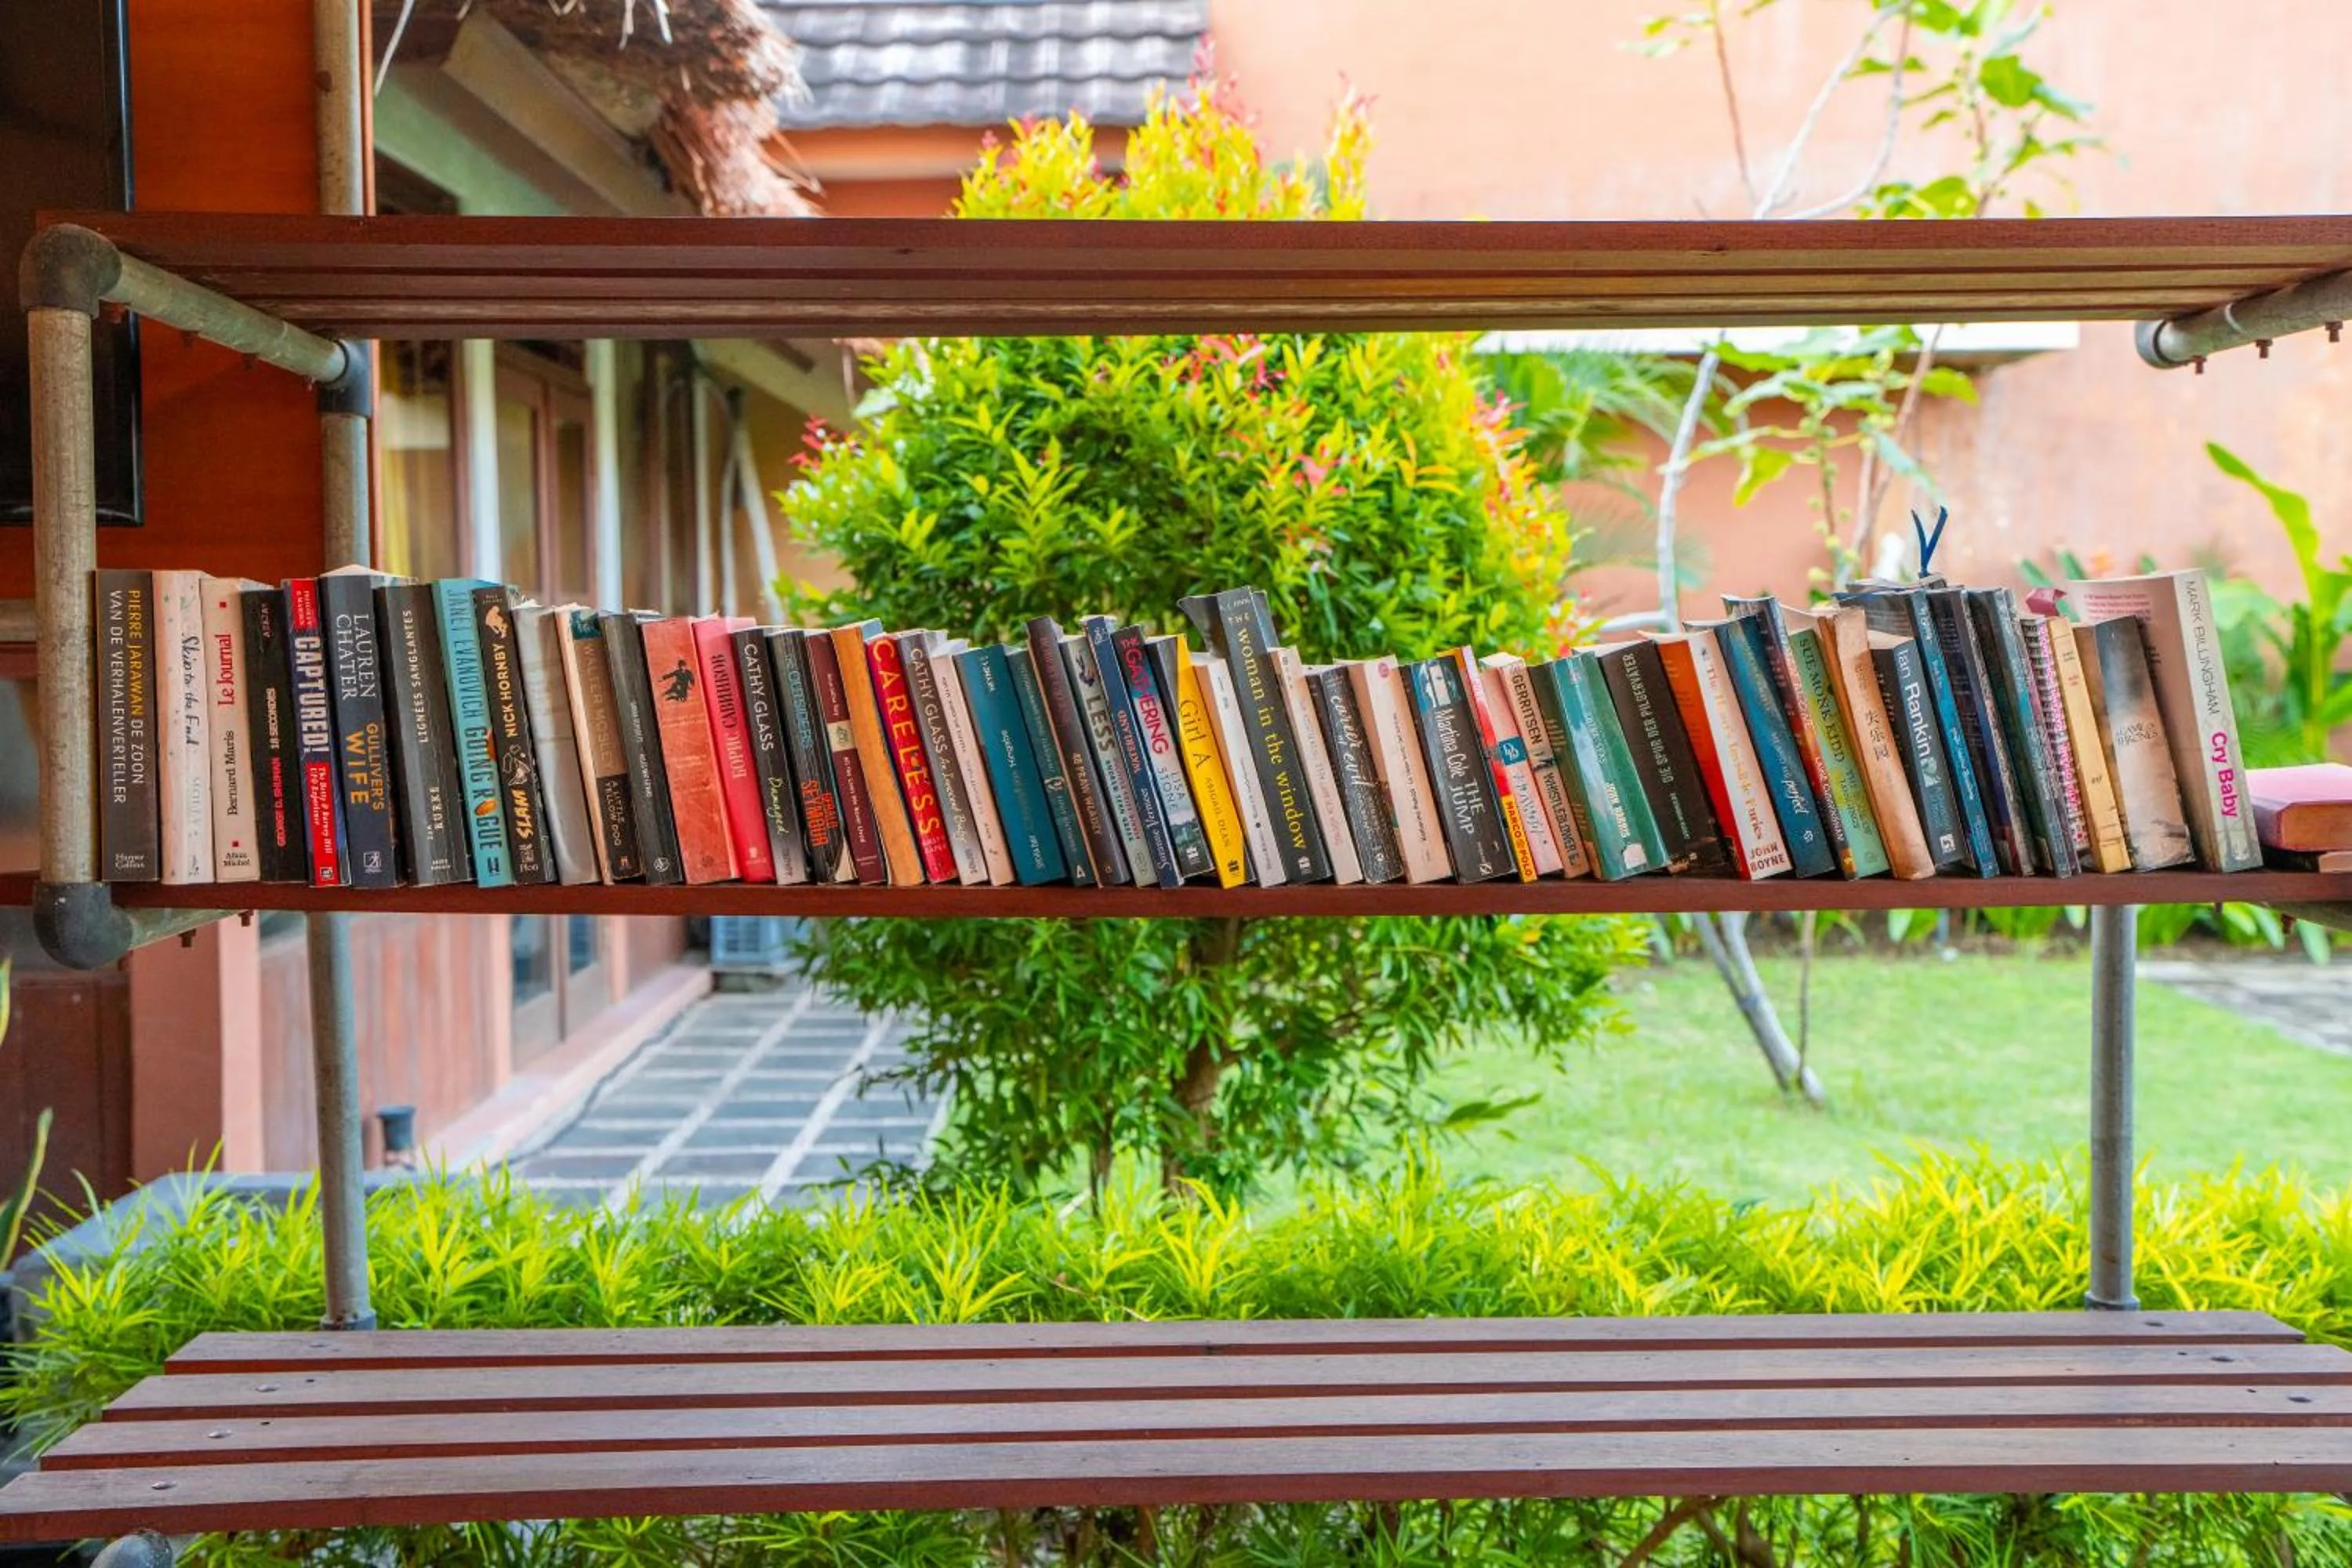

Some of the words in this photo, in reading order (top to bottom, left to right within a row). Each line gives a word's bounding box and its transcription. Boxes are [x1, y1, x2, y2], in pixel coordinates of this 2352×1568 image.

[110, 591, 122, 620] VAN
[128, 590, 142, 639] PIERRE
[447, 590, 471, 631] JANET
[111, 626, 122, 644] DE
[181, 633, 199, 670] Skip
[214, 633, 234, 684] Journal
[336, 615, 357, 700] CHATER
[354, 615, 377, 698] LAUREN
[402, 610, 421, 688] SANGLANTES
[2185, 580, 2201, 622] MARK
[2194, 626, 2220, 715] BILLINGHAM
[126, 644, 143, 715] JARAWAN
[184, 673, 193, 684] to
[455, 640, 485, 718] EVANOVICH
[492, 642, 510, 700] HORNBY
[744, 644, 765, 698] CATHY
[1236, 628, 1265, 700] woman
[1897, 650, 1912, 678] Ian
[184, 693, 199, 710] the
[218, 689, 234, 705] Le
[295, 636, 329, 753] CAPTURED!
[414, 693, 428, 743] LIGNÉES
[503, 701, 517, 737] NICK
[583, 644, 603, 704] WALTER
[595, 709, 613, 769] MOSLEY
[910, 648, 934, 699] CATHY
[925, 703, 947, 753] GLASS
[1125, 648, 1170, 754] GATHERING
[1258, 706, 1274, 727] in
[1512, 674, 1543, 745] GERRITSEN
[1799, 638, 1816, 670] SUE
[1808, 673, 1835, 720] MONK
[1827, 724, 1846, 762] KIDD
[1904, 681, 1933, 757] Rankin
[111, 652, 125, 803] VERHALENVERTELLER
[131, 720, 143, 736] DE
[186, 715, 199, 746] End
[754, 701, 773, 751] GLASS
[873, 640, 940, 834] CARELESS
[1087, 695, 1115, 753] LESS
[1178, 700, 1208, 742] Girl
[1434, 708, 1461, 753] Martina
[1642, 718, 1659, 738] DER
[132, 744, 143, 783] ZOON
[223, 730, 234, 765] Maris
[345, 731, 369, 804] WIFE
[366, 723, 384, 810] GULLIVER'S
[465, 727, 492, 782] GOING
[1191, 752, 1211, 768] A
[1264, 734, 1285, 765] the
[1446, 753, 1468, 779] Cole
[1650, 740, 1668, 765] SPUR
[2211, 732, 2228, 763] Cry
[224, 768, 238, 815] Bernard
[1464, 778, 1486, 817] THE
[1659, 766, 1675, 784] DIE
[2217, 768, 2238, 817] Baby
[512, 789, 534, 840] SLAM
[766, 777, 789, 835] Damaged
[801, 779, 828, 847] SEYMOUR
[1276, 771, 1306, 850] window
[1448, 785, 1475, 835] JUMP
[1543, 772, 1576, 852] WHISTLEBLOWER
[1506, 801, 1522, 838] MARCO
[1517, 850, 1533, 877] POLO
[1749, 854, 1788, 873] BOYNE
